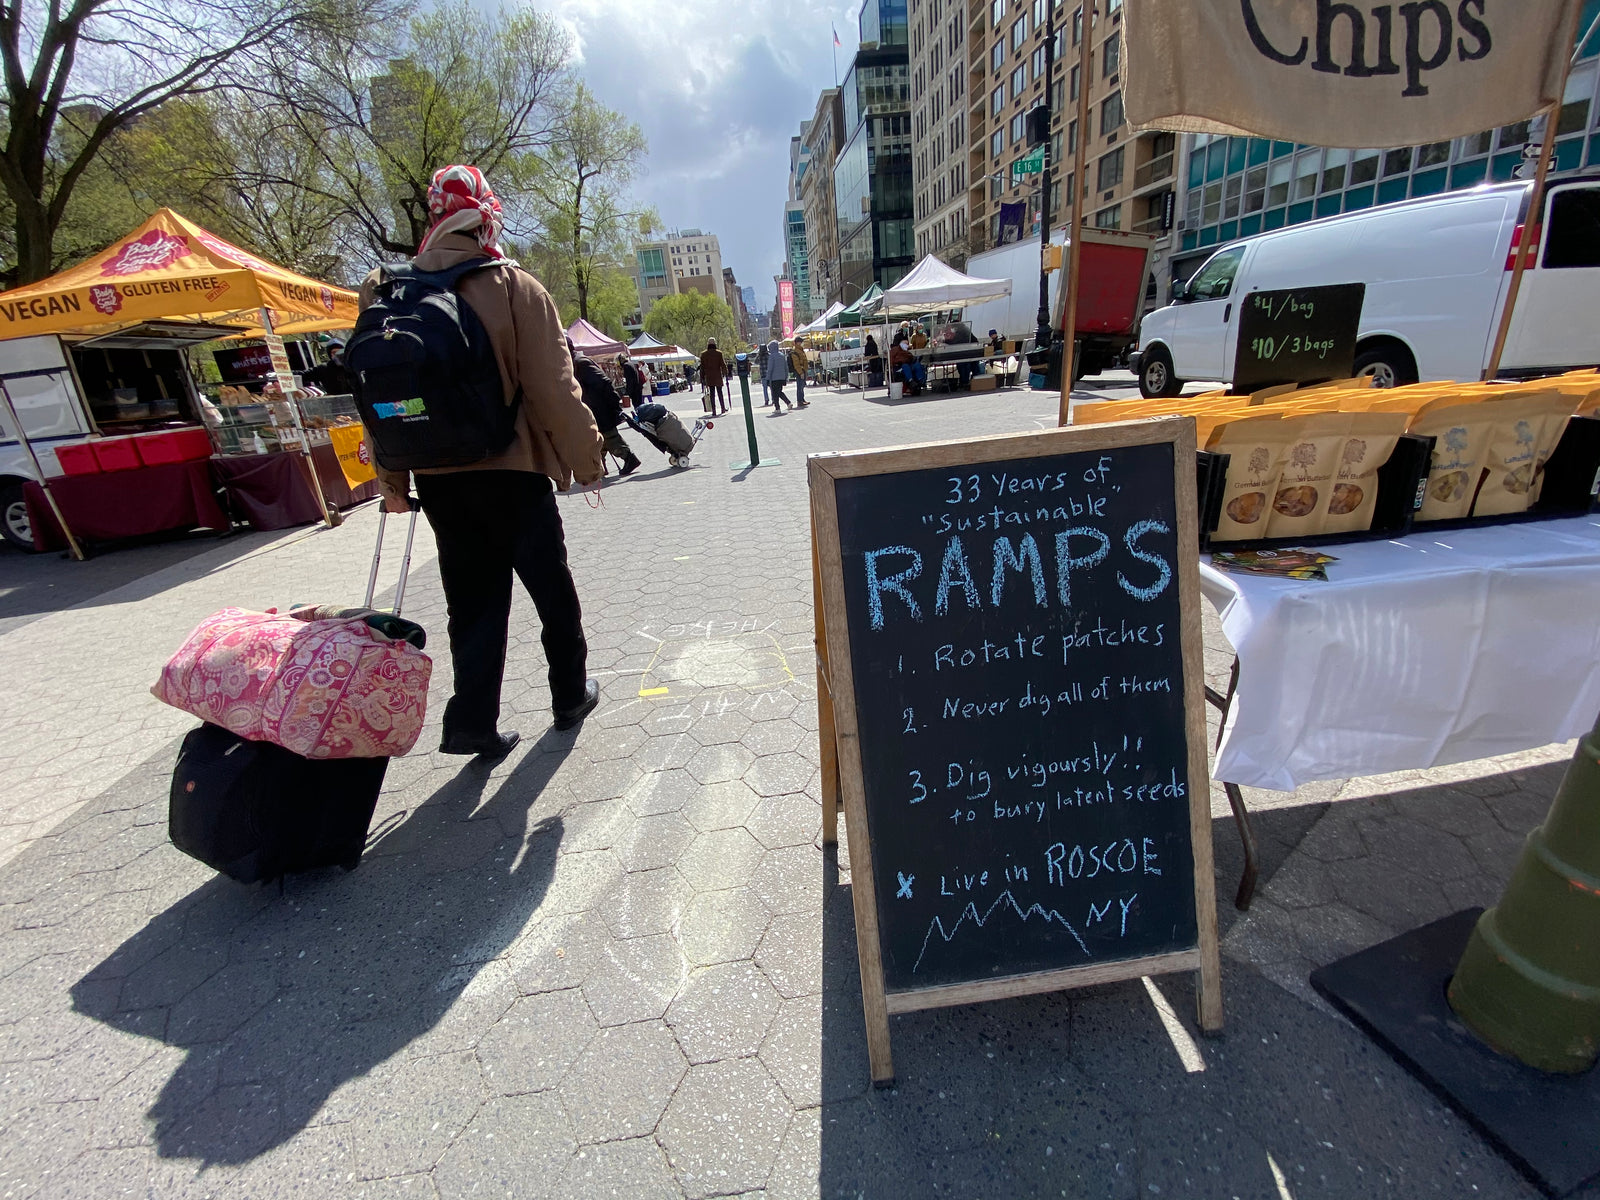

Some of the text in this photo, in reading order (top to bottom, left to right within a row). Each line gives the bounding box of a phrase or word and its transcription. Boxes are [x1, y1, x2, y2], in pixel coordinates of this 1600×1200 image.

[1240, 0, 1492, 97] Chips
[1017, 162, 1021, 172] E
[1024, 161, 1032, 171] 16
[0, 293, 81, 322] VEGAN
[122, 276, 219, 297] GLUTEN FREE
[278, 281, 319, 303] VEGAN
[1304, 336, 1335, 359] bags
[945, 456, 1113, 504] 33 Years of
[863, 518, 1173, 632] RAMPS
[897, 616, 1166, 675] 1. Rotate patches
[902, 675, 1172, 734] 2. Never dig all of them
[908, 769, 937, 804] 3.
[946, 758, 992, 801] Dig
[949, 767, 1186, 825] to bury latent seeds
[940, 837, 1162, 896] Live in ROSCOE
[1086, 894, 1138, 937] NY
